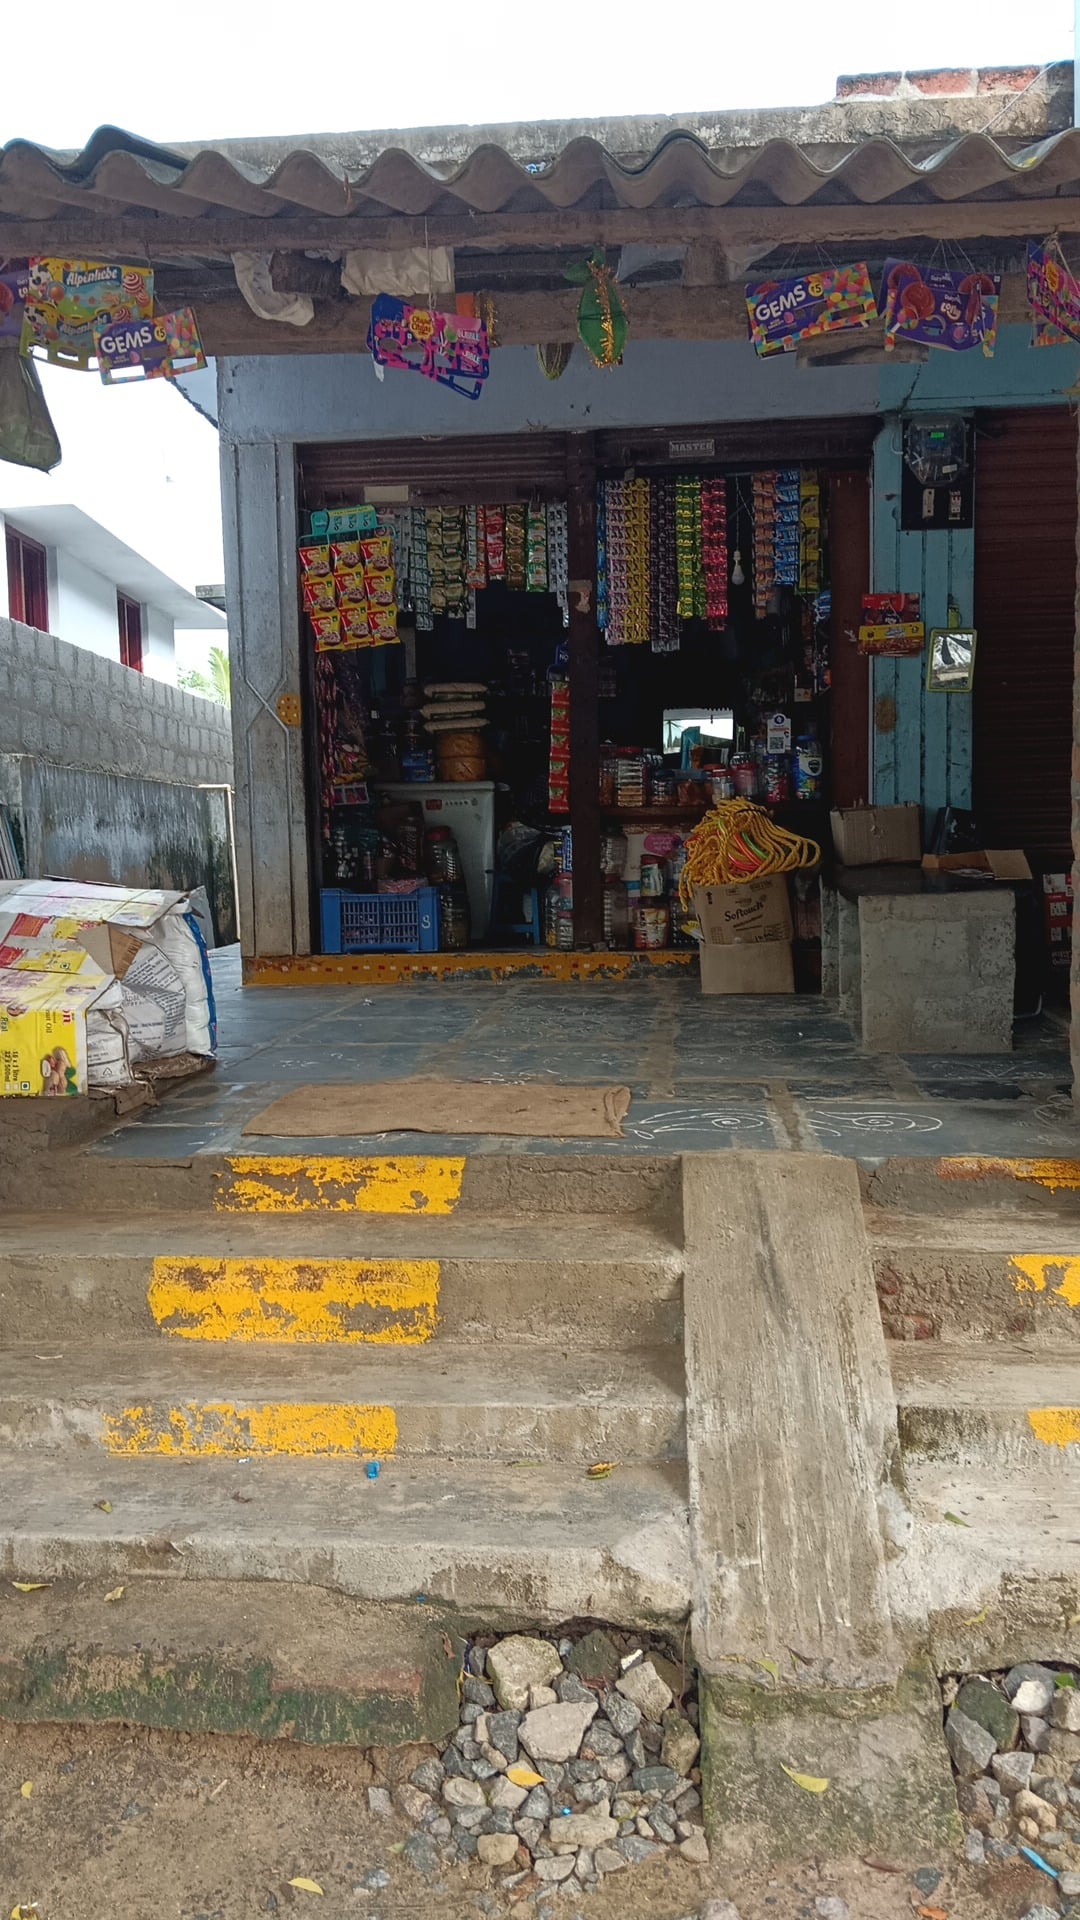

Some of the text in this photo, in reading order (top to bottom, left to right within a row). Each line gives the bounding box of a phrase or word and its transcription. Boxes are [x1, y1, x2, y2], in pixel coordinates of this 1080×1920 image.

[66, 267, 118, 288] Alpenliebe
[755, 285, 806, 321] GEMS
[100, 326, 152, 354] GEMS
[671, 442, 713, 452] MASTER
[724, 901, 764, 922] Softouch
[1, 1016, 9, 1032] Real
